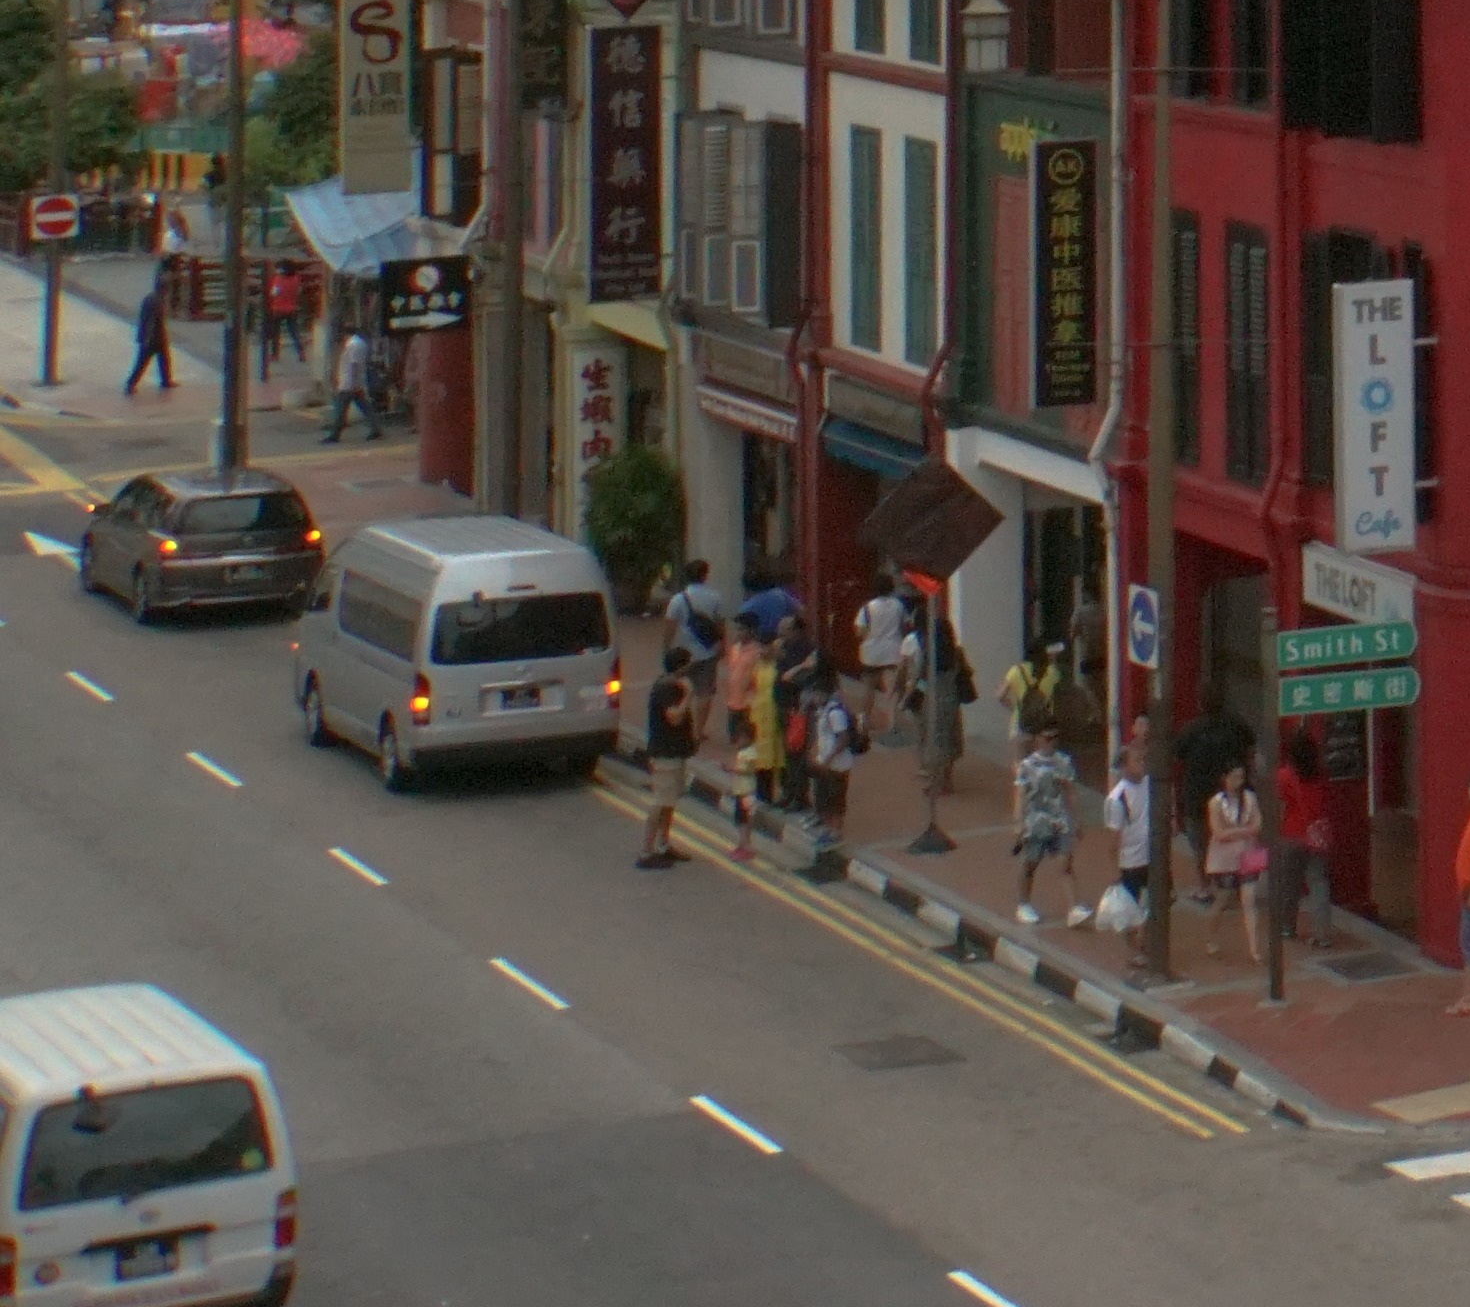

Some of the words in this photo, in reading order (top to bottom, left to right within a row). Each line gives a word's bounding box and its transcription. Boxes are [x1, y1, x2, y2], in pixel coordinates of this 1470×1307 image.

[1351, 295, 1403, 324] THE
[1354, 509, 1402, 538] Cafe
[1285, 630, 1363, 663] Smith
[1374, 628, 1400, 653] St
